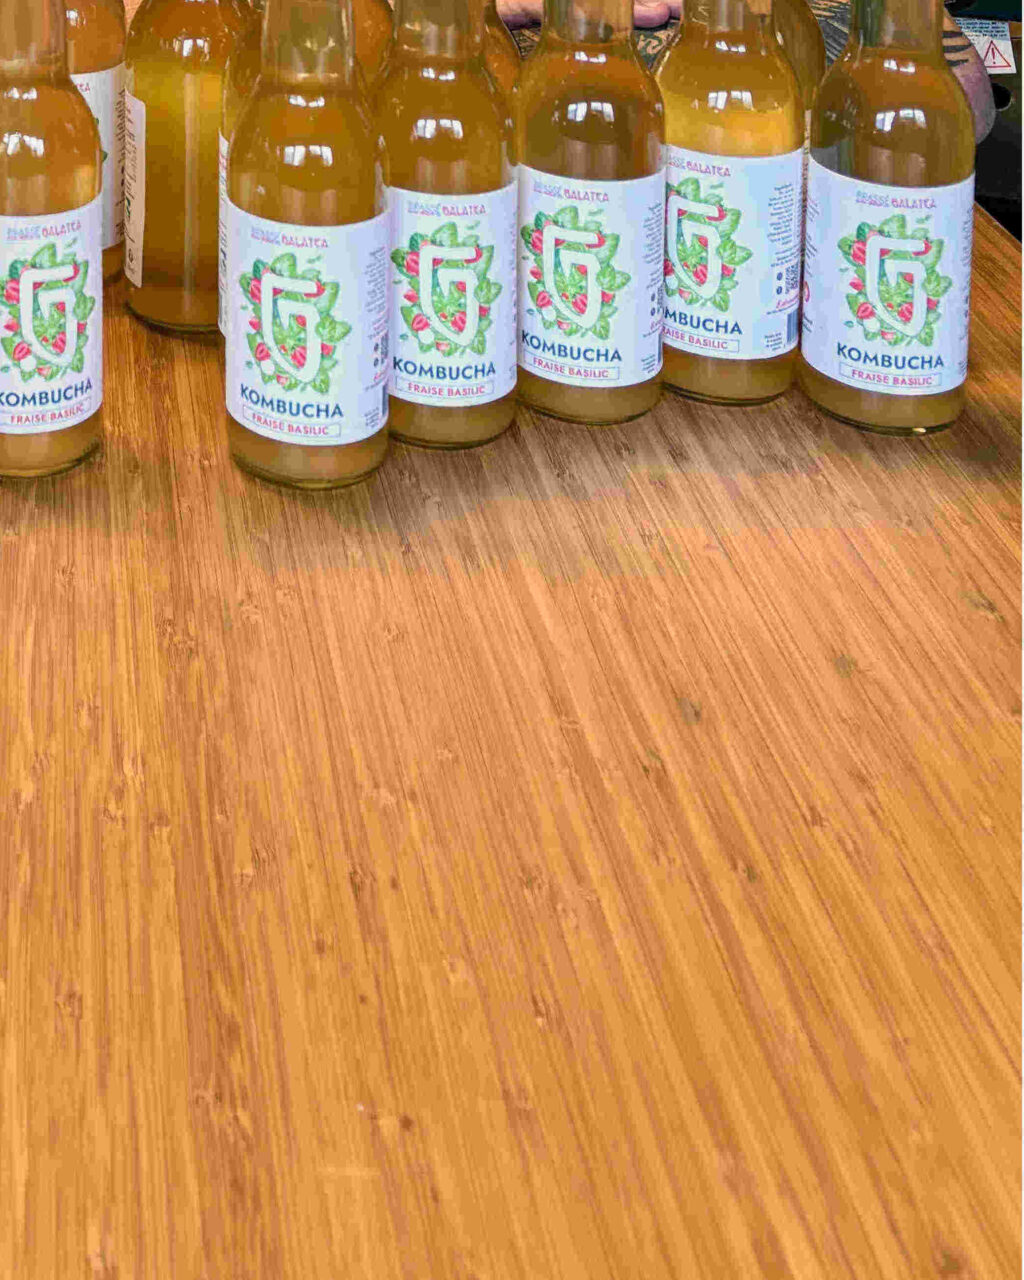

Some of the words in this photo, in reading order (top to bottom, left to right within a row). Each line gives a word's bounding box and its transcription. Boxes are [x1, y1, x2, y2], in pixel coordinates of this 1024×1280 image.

[661, 308, 743, 336] MBUCHA
[521, 329, 623, 363] KOMBUCHA
[662, 326, 686, 342] RAISE
[688, 336, 728, 350] BASILIC
[393, 355, 497, 381] KOMBUCHA
[532, 356, 565, 375] FRAISE
[568, 365, 609, 379] BASILIC
[837, 341, 945, 370] KOMBUCHA
[407, 382, 444, 397] FRAISE
[447, 385, 486, 397] BASILIC
[851, 369, 890, 385] FRAISE
[893, 373, 933, 387] BASILIC
[10, 412, 48, 425] FRAISE
[50, 403, 85, 423] BASILIC
[239, 383, 345, 420] KOMBUCHA
[251, 411, 285, 433] FRAISE
[287, 423, 329, 437] BASILIC
